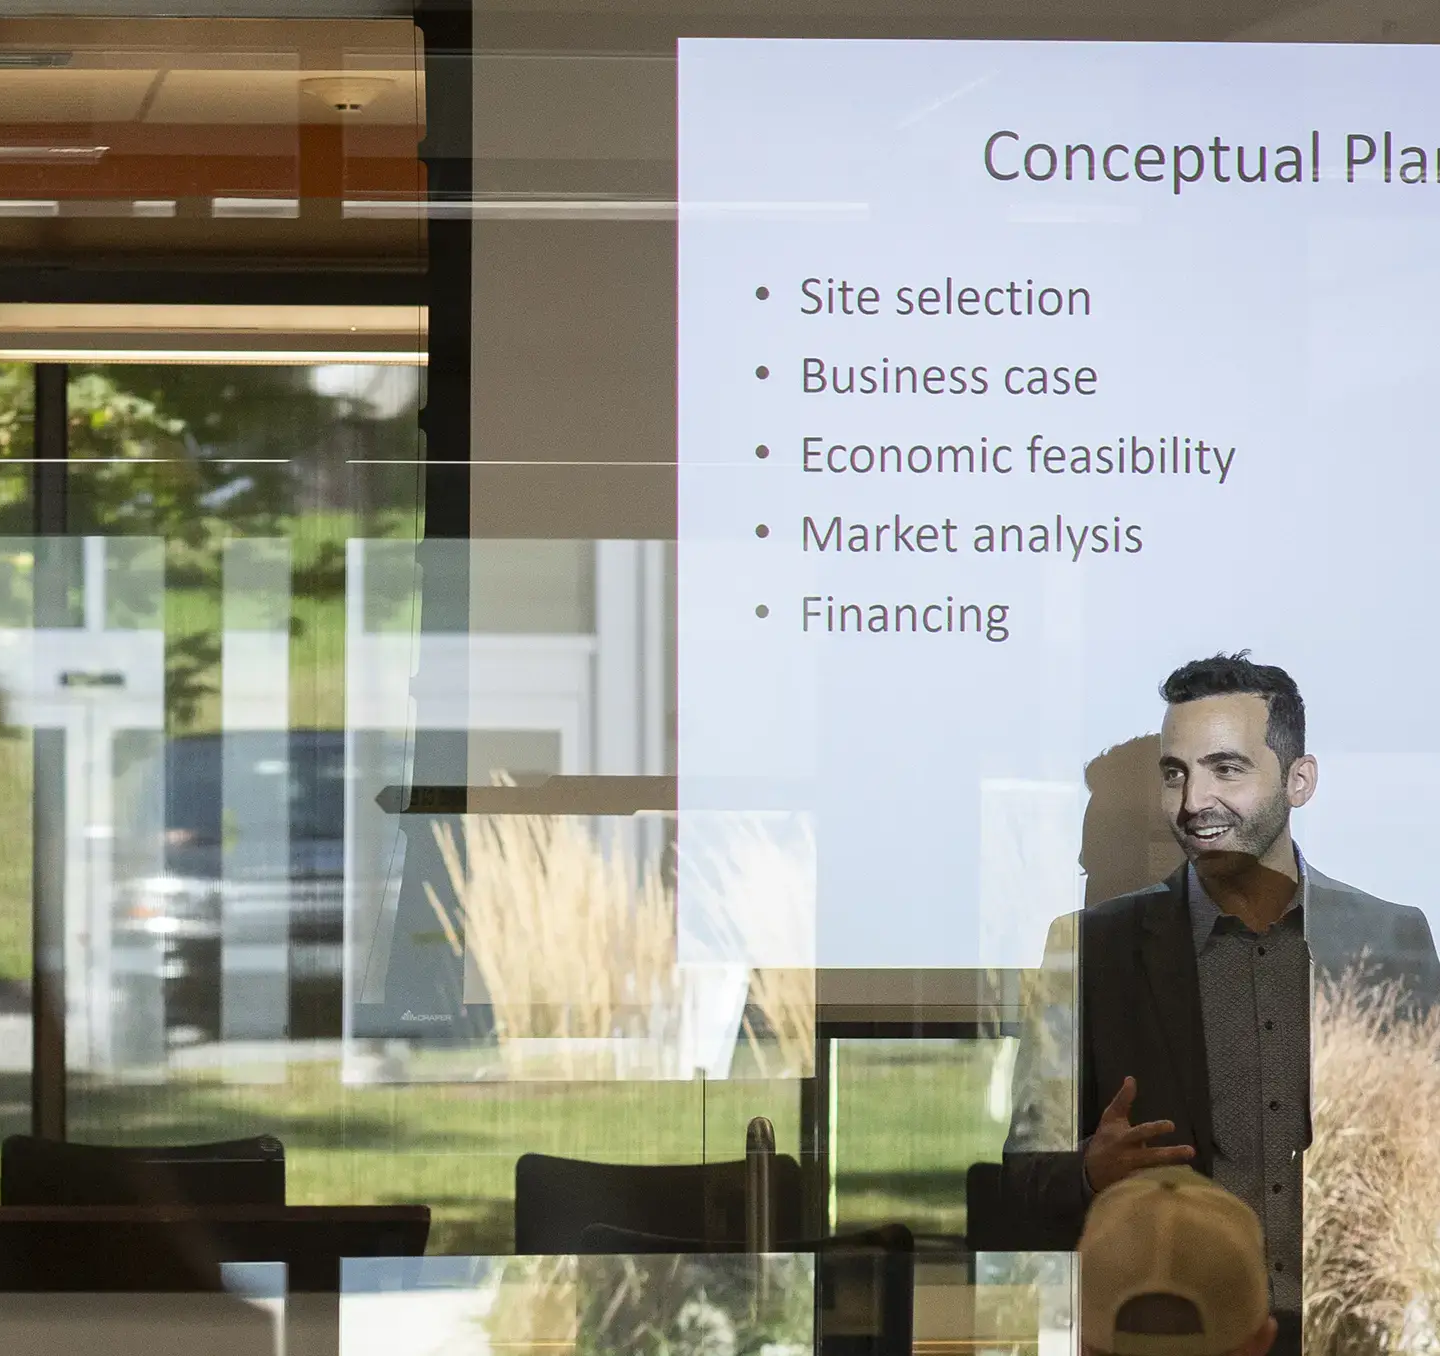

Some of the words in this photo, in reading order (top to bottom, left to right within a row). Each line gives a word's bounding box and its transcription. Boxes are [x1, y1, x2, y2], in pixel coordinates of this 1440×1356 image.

[984, 129, 1320, 196] Conceptual
[799, 277, 881, 317] Site
[895, 276, 1092, 318] selection
[801, 357, 989, 396] Business
[1004, 366, 1098, 396] case
[801, 436, 1013, 475] Economic
[1027, 434, 1236, 485] feasibility
[801, 514, 958, 553] Market
[973, 514, 1143, 562] analysis
[801, 596, 1010, 643] Financing
[417, 1014, 453, 1022] DRAPER
